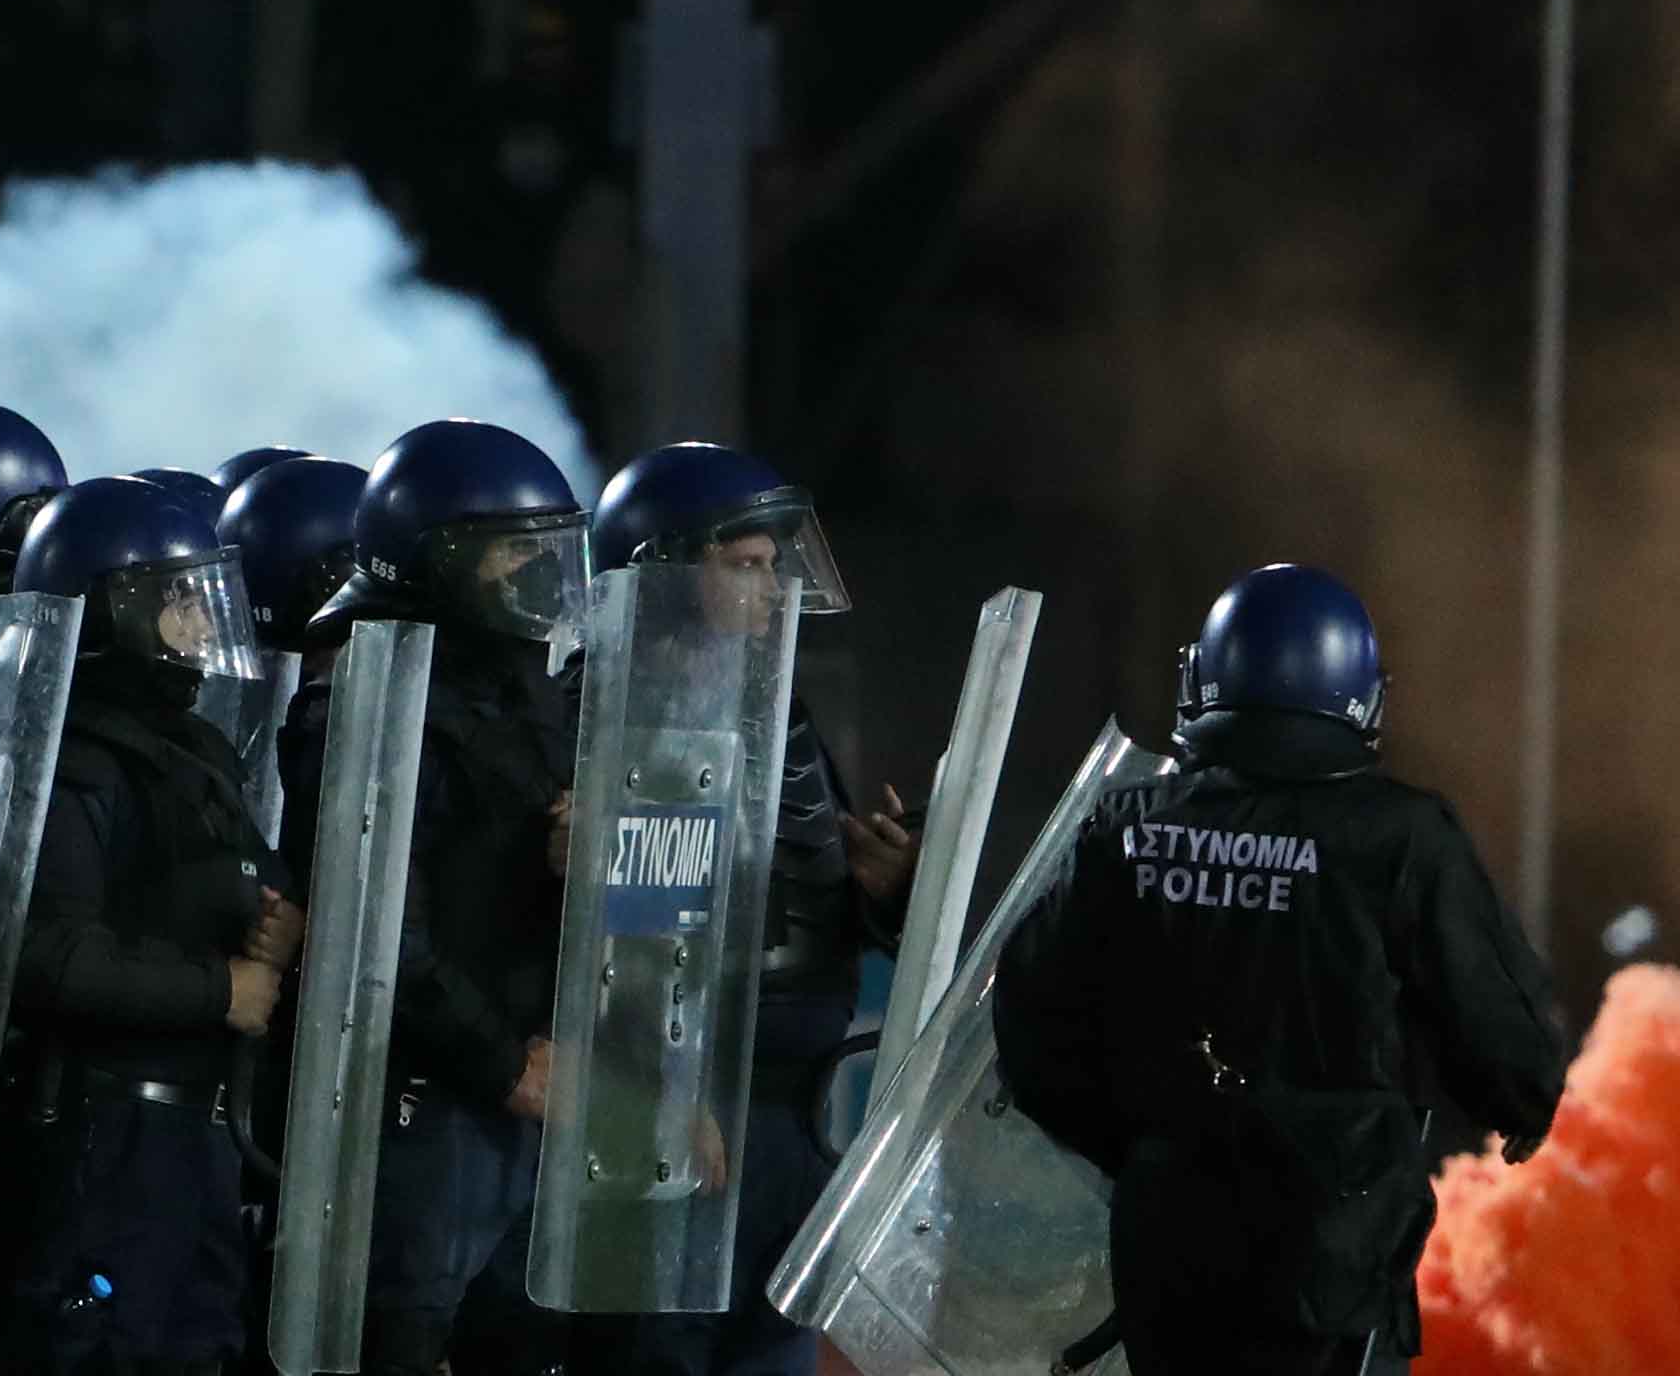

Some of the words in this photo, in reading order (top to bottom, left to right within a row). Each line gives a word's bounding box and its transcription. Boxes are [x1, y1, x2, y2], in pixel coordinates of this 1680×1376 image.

[371, 555, 397, 581] E65
[606, 816, 716, 888] ΣΤΥΝΟΜΙΑ
[1136, 864, 1292, 912] POLICE
